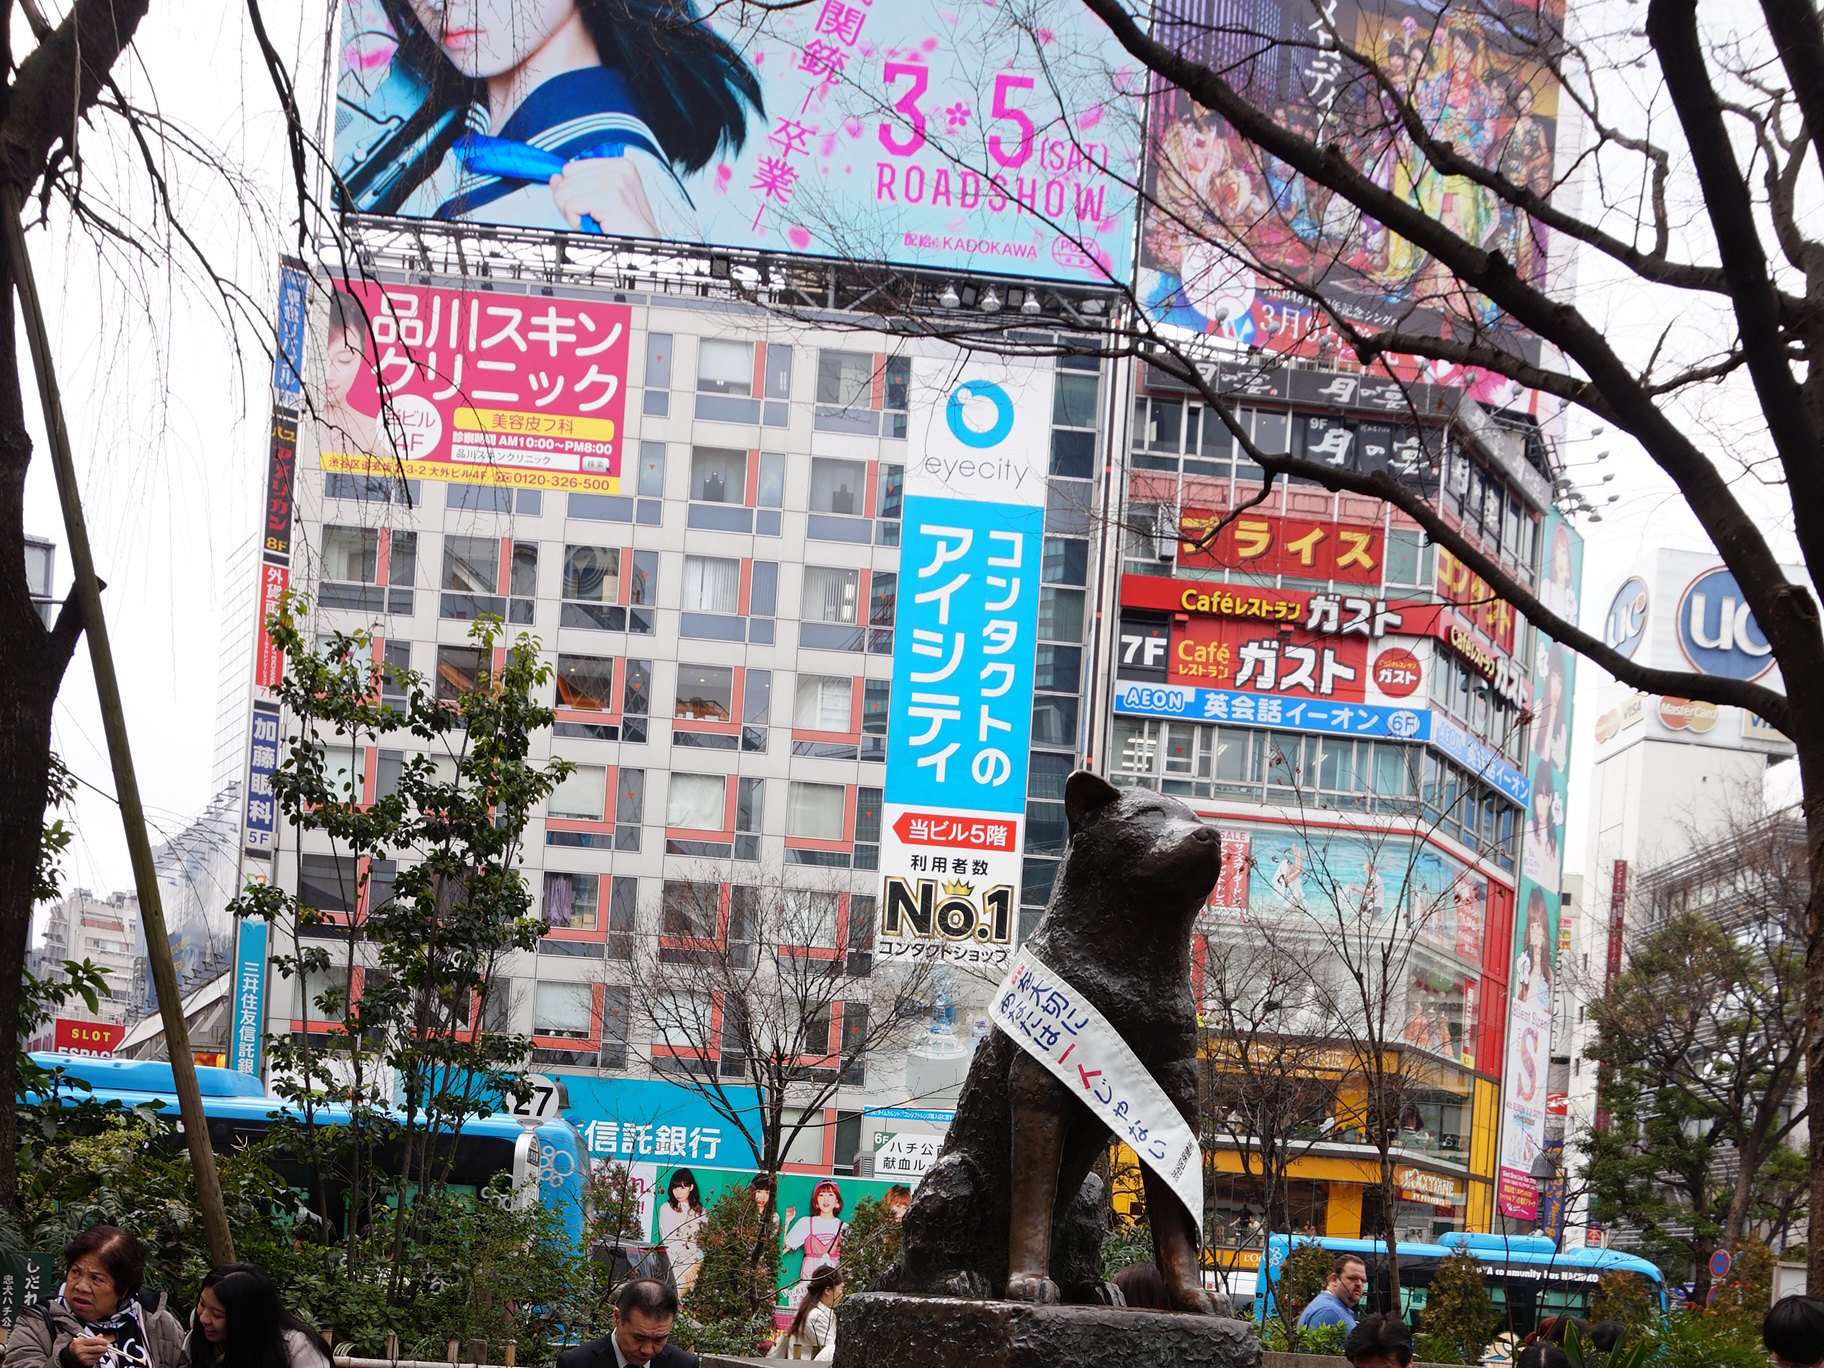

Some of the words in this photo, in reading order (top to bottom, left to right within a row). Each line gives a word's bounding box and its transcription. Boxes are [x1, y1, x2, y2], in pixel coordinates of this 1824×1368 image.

[878, 62, 929, 157] 3
[988, 74, 1035, 169] 5
[1040, 137, 1109, 177] (SAT)
[876, 163, 1105, 222] ROADSHOW
[943, 236, 1038, 259] KADOKAWA
[372, 292, 623, 357] 品川スキン
[370, 347, 618, 412] クリニック
[491, 412, 574, 435] 美容皮フ科
[395, 432, 424, 452] 4F
[455, 447, 551, 466] 品川スキンクリニック
[513, 472, 610, 491] 0120-326-500
[924, 456, 1029, 489] eyecity
[266, 537, 288, 551] 8F
[1306, 593, 1403, 638] ガスト
[907, 523, 974, 784] アイシティ
[971, 530, 1023, 788] コンタクトの
[1120, 635, 1167, 665] 7F
[1178, 640, 1231, 664] Café
[1178, 663, 1229, 680] レストラン
[1234, 640, 1357, 695] ガスト
[1378, 668, 1418, 686] ガスト
[1126, 688, 1184, 711] AEON
[1203, 692, 1379, 731] 英会話イーオン
[1660, 702, 1718, 719] MasterCard
[248, 717, 277, 824] 加藤眼科
[248, 831, 269, 844] 5F
[908, 818, 1008, 847] 当ビル5階
[910, 854, 989, 876] 利用者数
[882, 876, 1014, 945] No.1
[879, 941, 1011, 963] コンタクトショップ
[71, 1028, 111, 1043] SLOT
[874, 1132, 889, 1144] 6F
